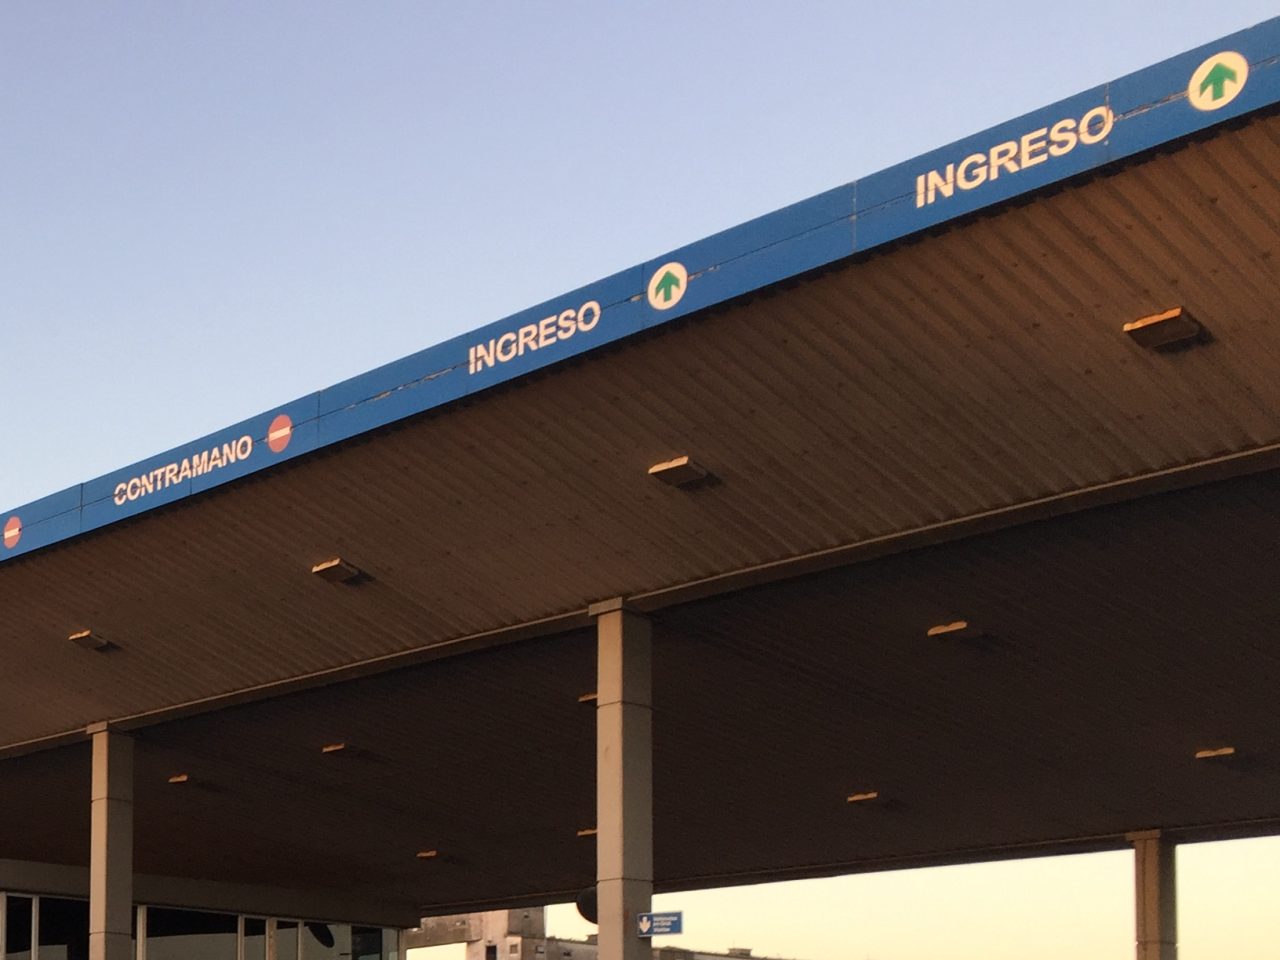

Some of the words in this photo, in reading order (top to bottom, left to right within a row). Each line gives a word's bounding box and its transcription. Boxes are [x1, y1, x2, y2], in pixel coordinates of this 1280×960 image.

[916, 105, 1114, 208] INGRESO
[468, 300, 602, 375] INGRESO
[113, 435, 254, 506] CONTRAMANO
